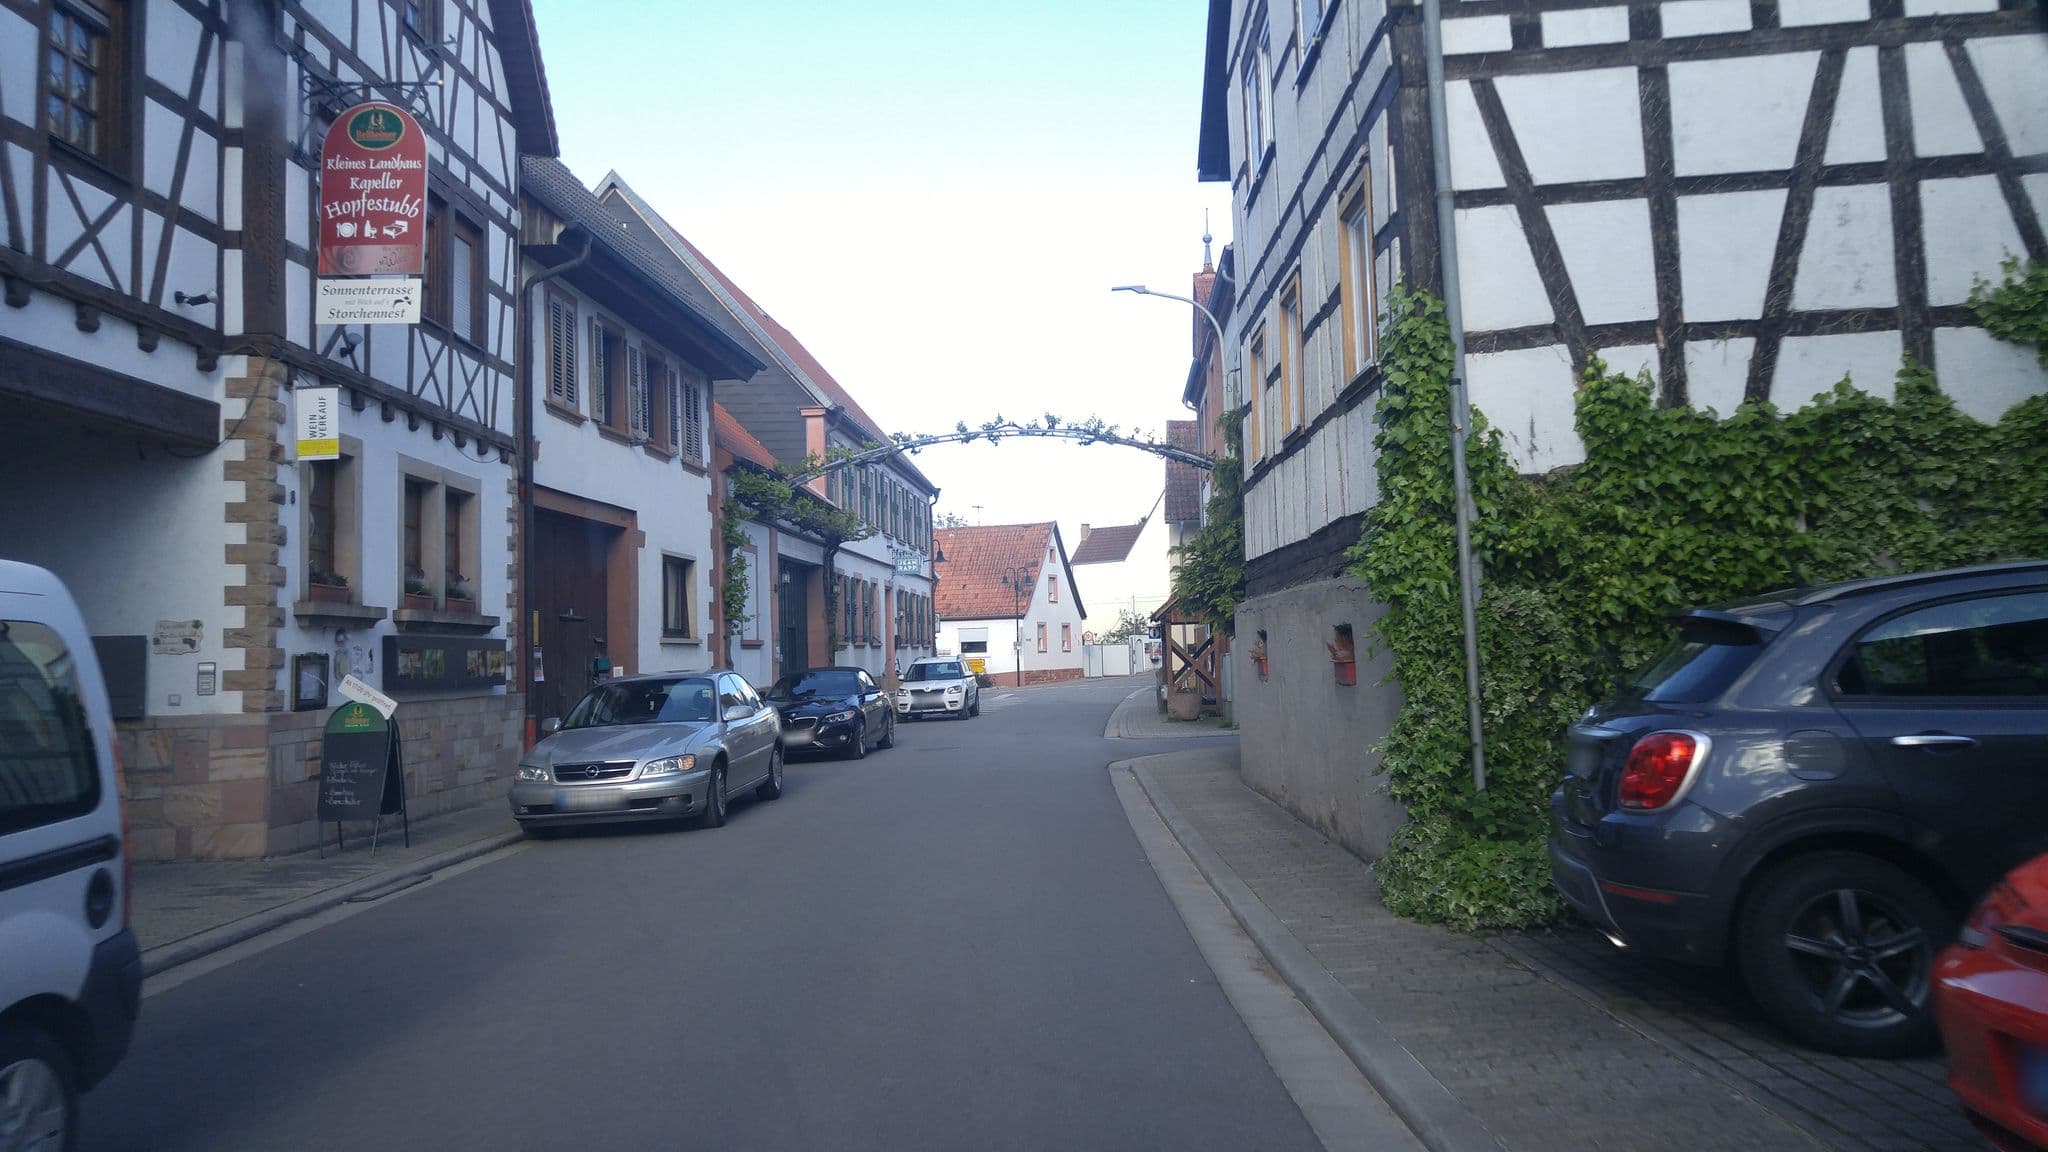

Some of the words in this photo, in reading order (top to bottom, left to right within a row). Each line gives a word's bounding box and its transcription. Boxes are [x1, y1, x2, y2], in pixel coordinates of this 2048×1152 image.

[327, 154, 366, 170] Kleines
[369, 154, 422, 170] Landhaus
[350, 172, 403, 193] Kapeller
[324, 190, 421, 220] Hopfestubb
[322, 285, 413, 296] Sonnenterrasse
[328, 308, 405, 319] Storchennest
[309, 414, 317, 438] WEIN
[318, 396, 327, 438] VERKAUF
